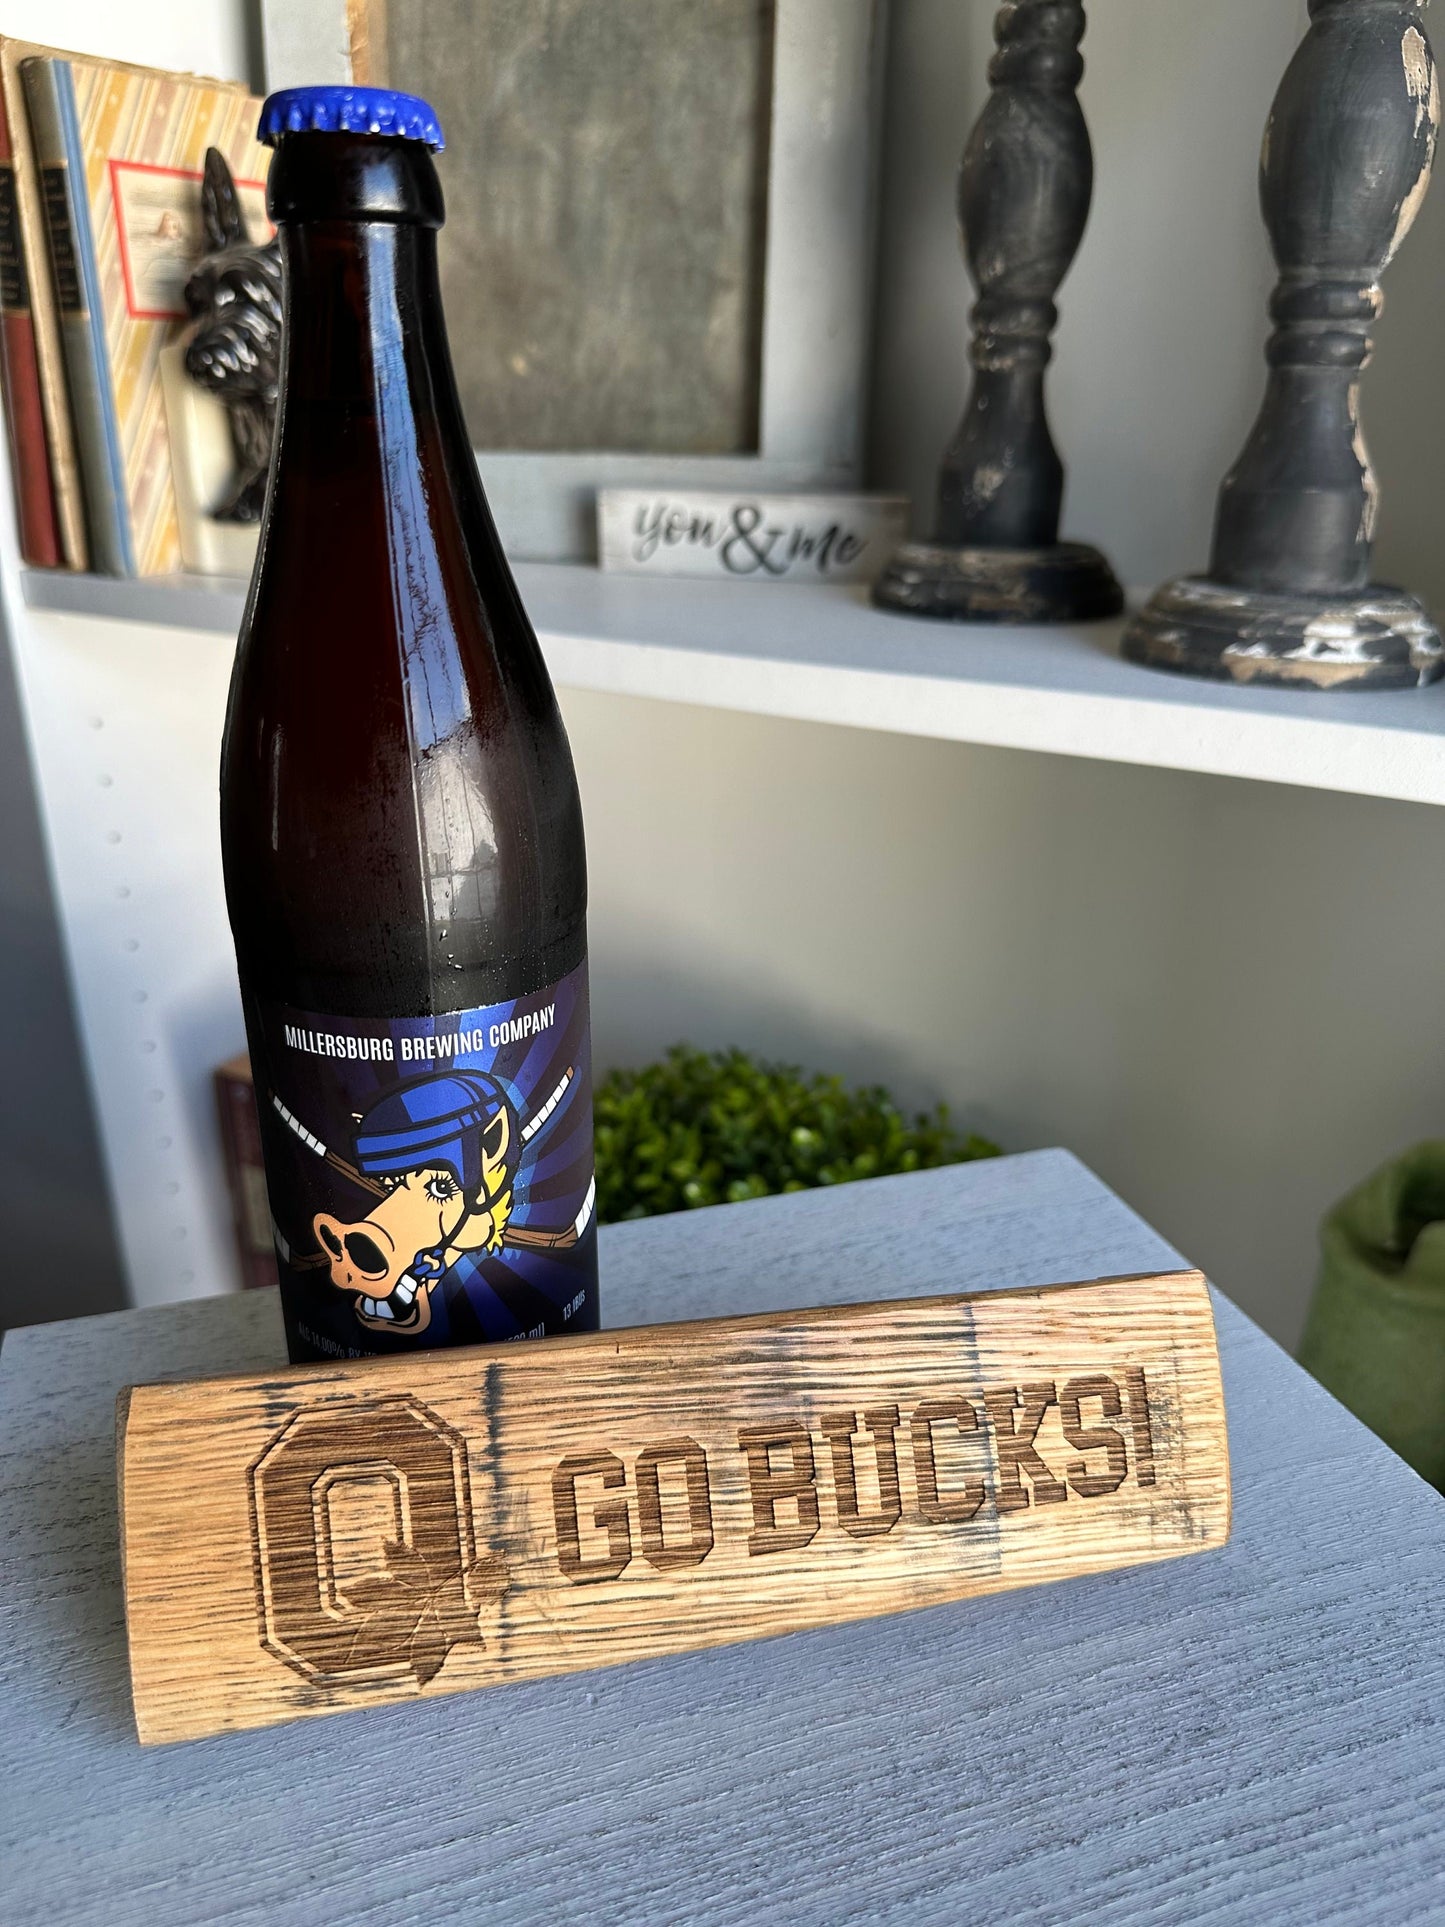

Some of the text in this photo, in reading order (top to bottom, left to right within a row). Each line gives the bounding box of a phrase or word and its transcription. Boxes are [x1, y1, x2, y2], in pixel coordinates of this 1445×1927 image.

[631, 501, 728, 562] you
[788, 524, 866, 572] me
[284, 1002, 556, 1061] MILLERSBURG BREWING COMPANY
[562, 1302, 573, 1321] 13
[551, 1365, 1155, 1585] GO BUCKS!
